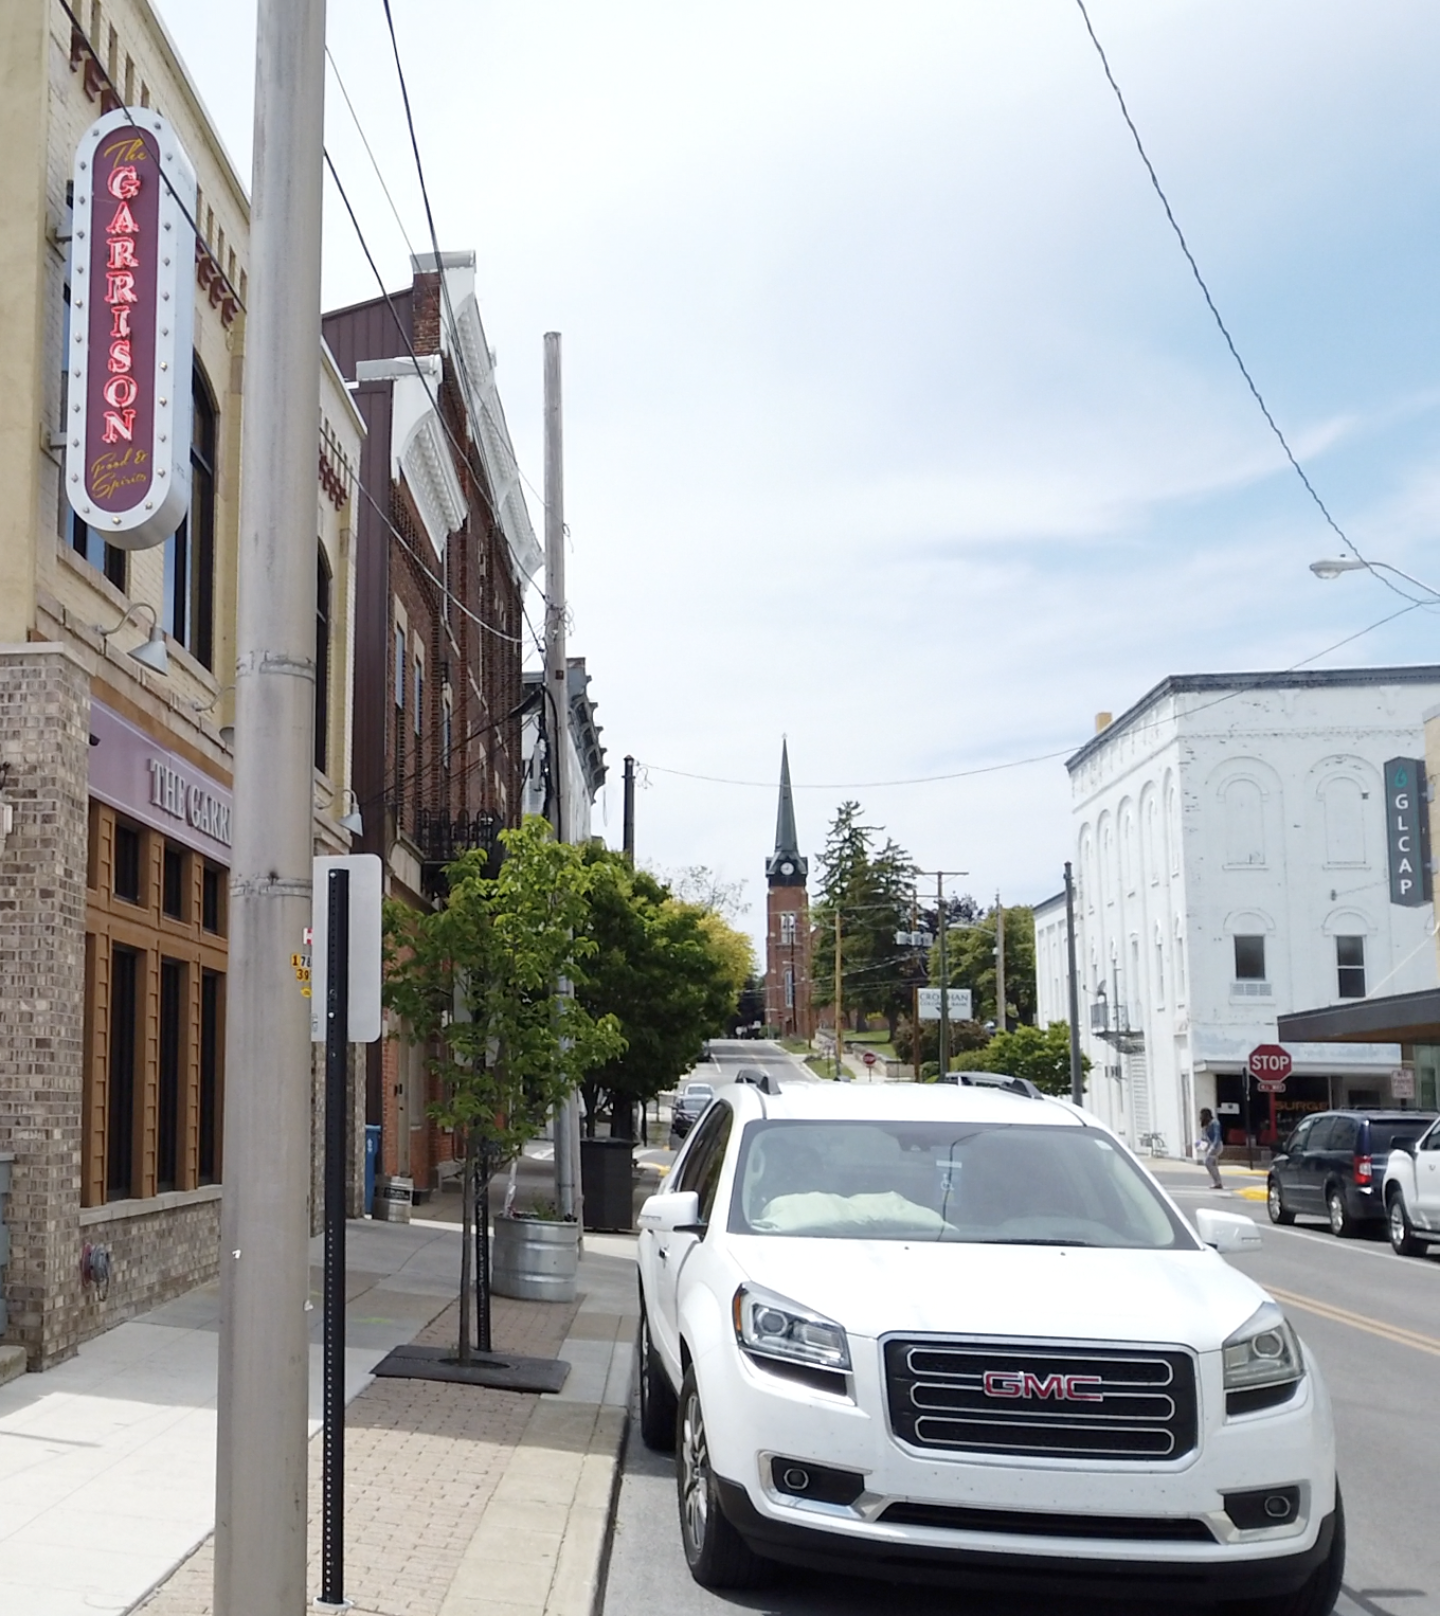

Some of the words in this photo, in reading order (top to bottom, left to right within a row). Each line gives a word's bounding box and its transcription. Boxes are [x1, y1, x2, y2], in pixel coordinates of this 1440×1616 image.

[103, 138, 147, 169] The
[102, 165, 141, 444] GARRISON
[91, 448, 133, 479] Food
[133, 449, 148, 464] &
[92, 471, 147, 499] Spirits
[147, 759, 185, 820] THE
[1395, 793, 1413, 895] GLCAP
[1251, 1055, 1289, 1070] STOP
[983, 1371, 1103, 1402] GMC
